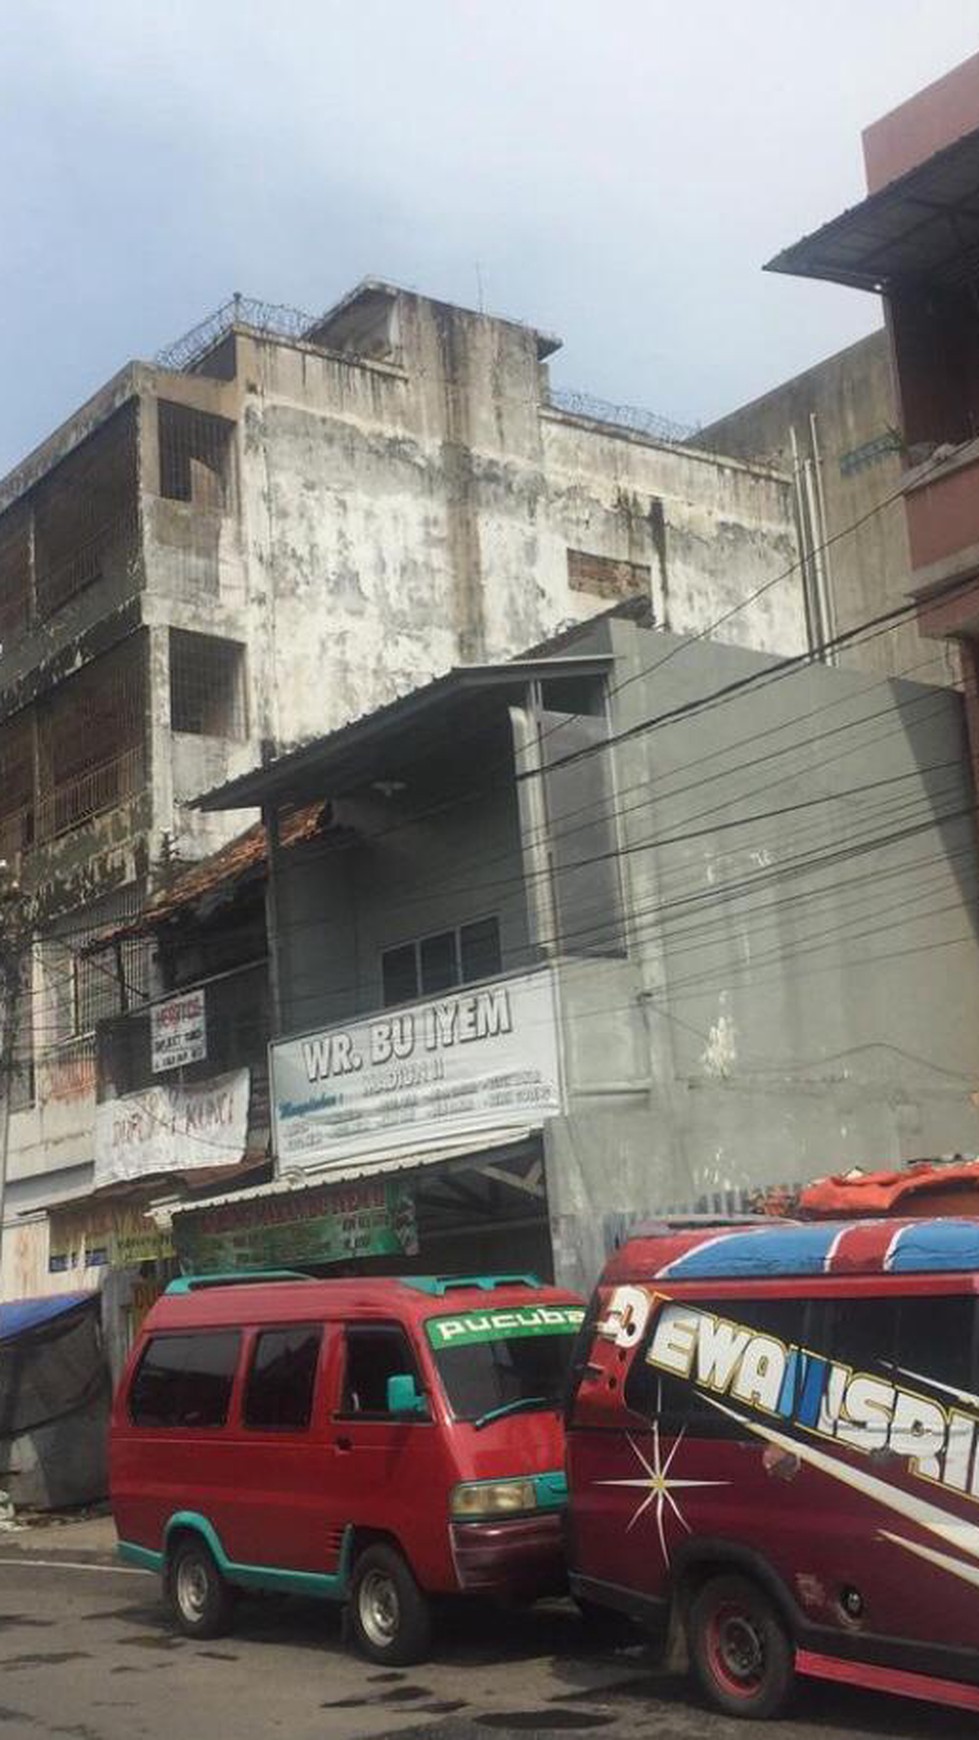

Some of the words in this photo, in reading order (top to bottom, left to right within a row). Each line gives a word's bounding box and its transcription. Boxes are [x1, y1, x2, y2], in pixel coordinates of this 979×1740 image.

[301, 1034, 363, 1083] WR.
[371, 1013, 415, 1066] BU
[424, 988, 513, 1051] IYEM
